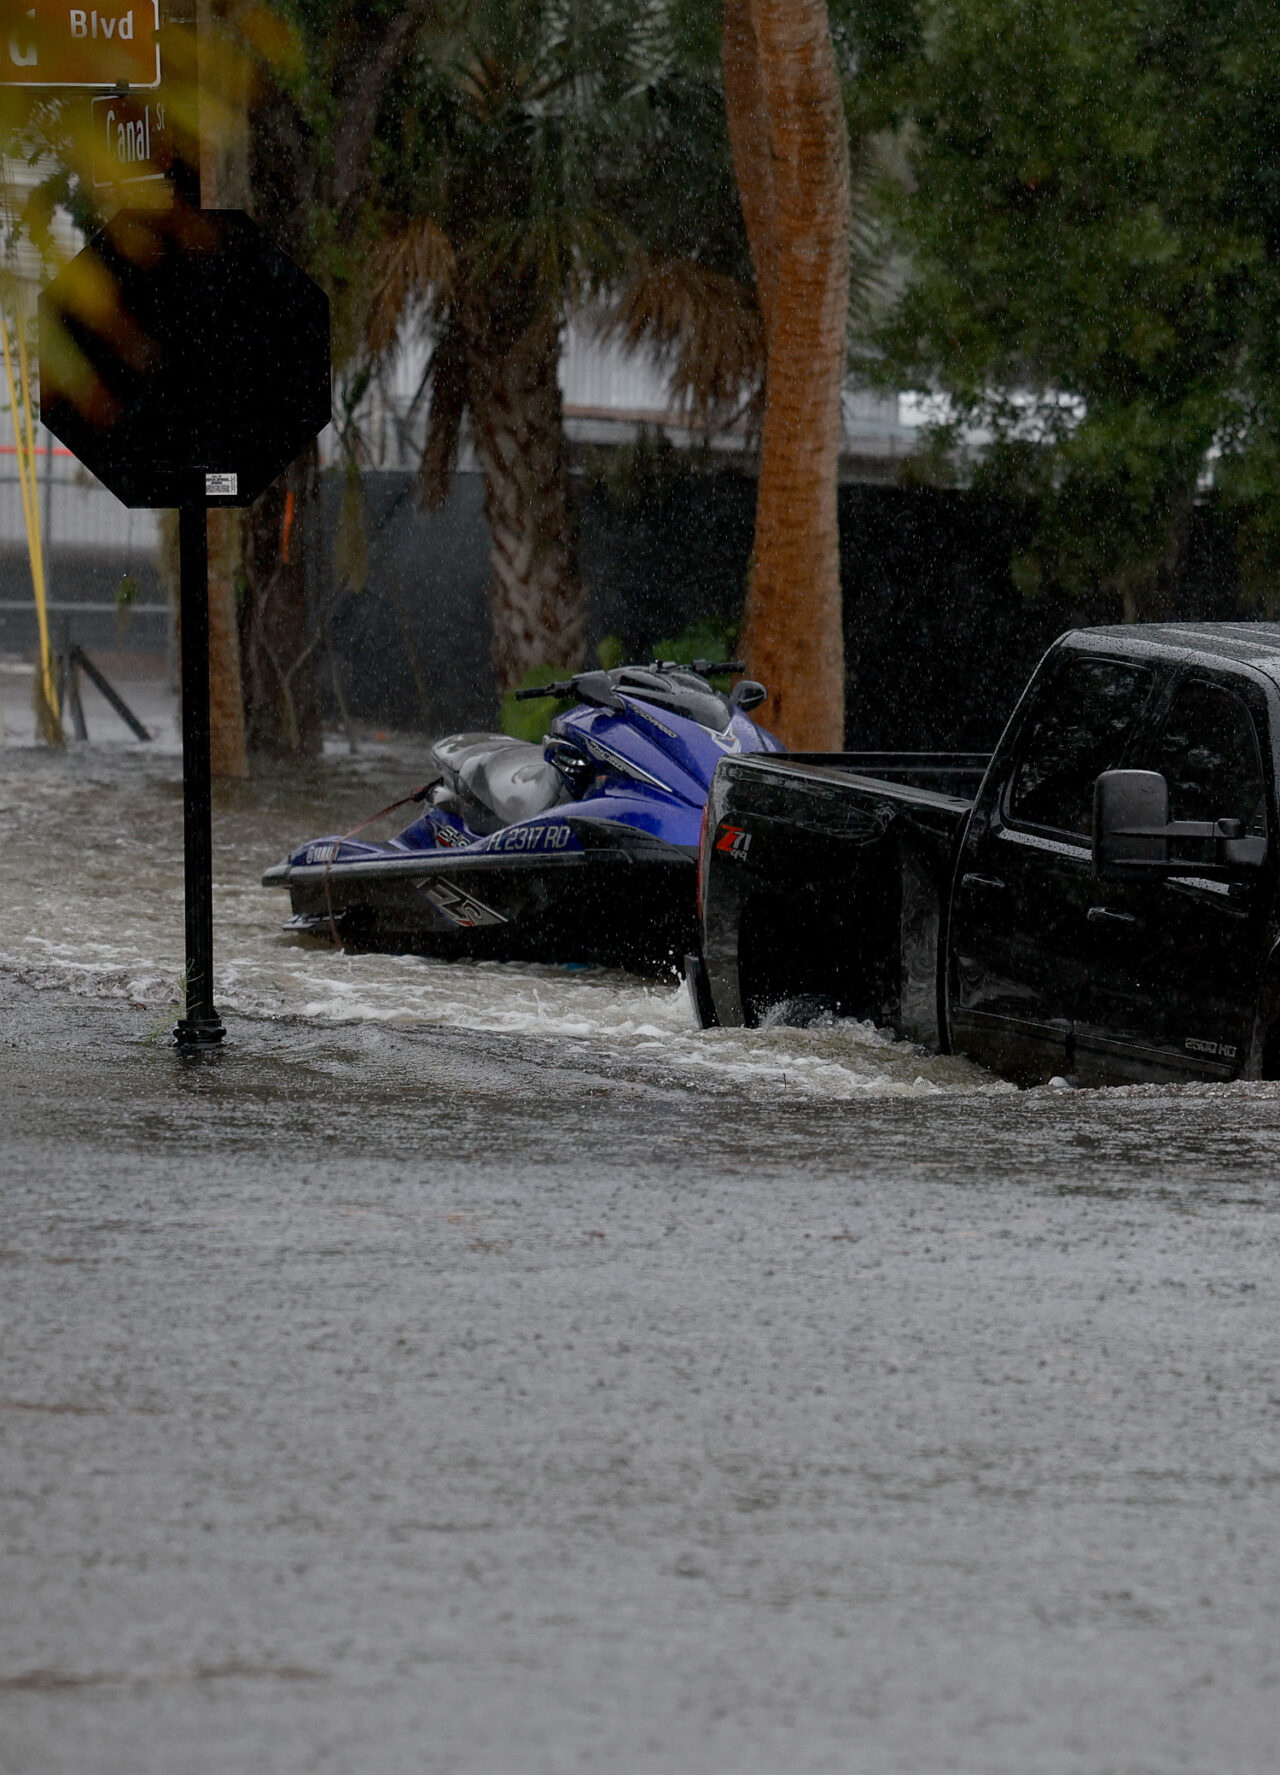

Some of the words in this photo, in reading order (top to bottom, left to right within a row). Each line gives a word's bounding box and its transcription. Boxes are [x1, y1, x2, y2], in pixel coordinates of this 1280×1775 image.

[70, 9, 133, 40] Blvd
[106, 104, 151, 163] Canal
[156, 102, 166, 131] St
[504, 827, 545, 851] 2317
[544, 826, 571, 849] RD
[716, 824, 751, 852] Z71
[1185, 1037, 1217, 1054] 2500
